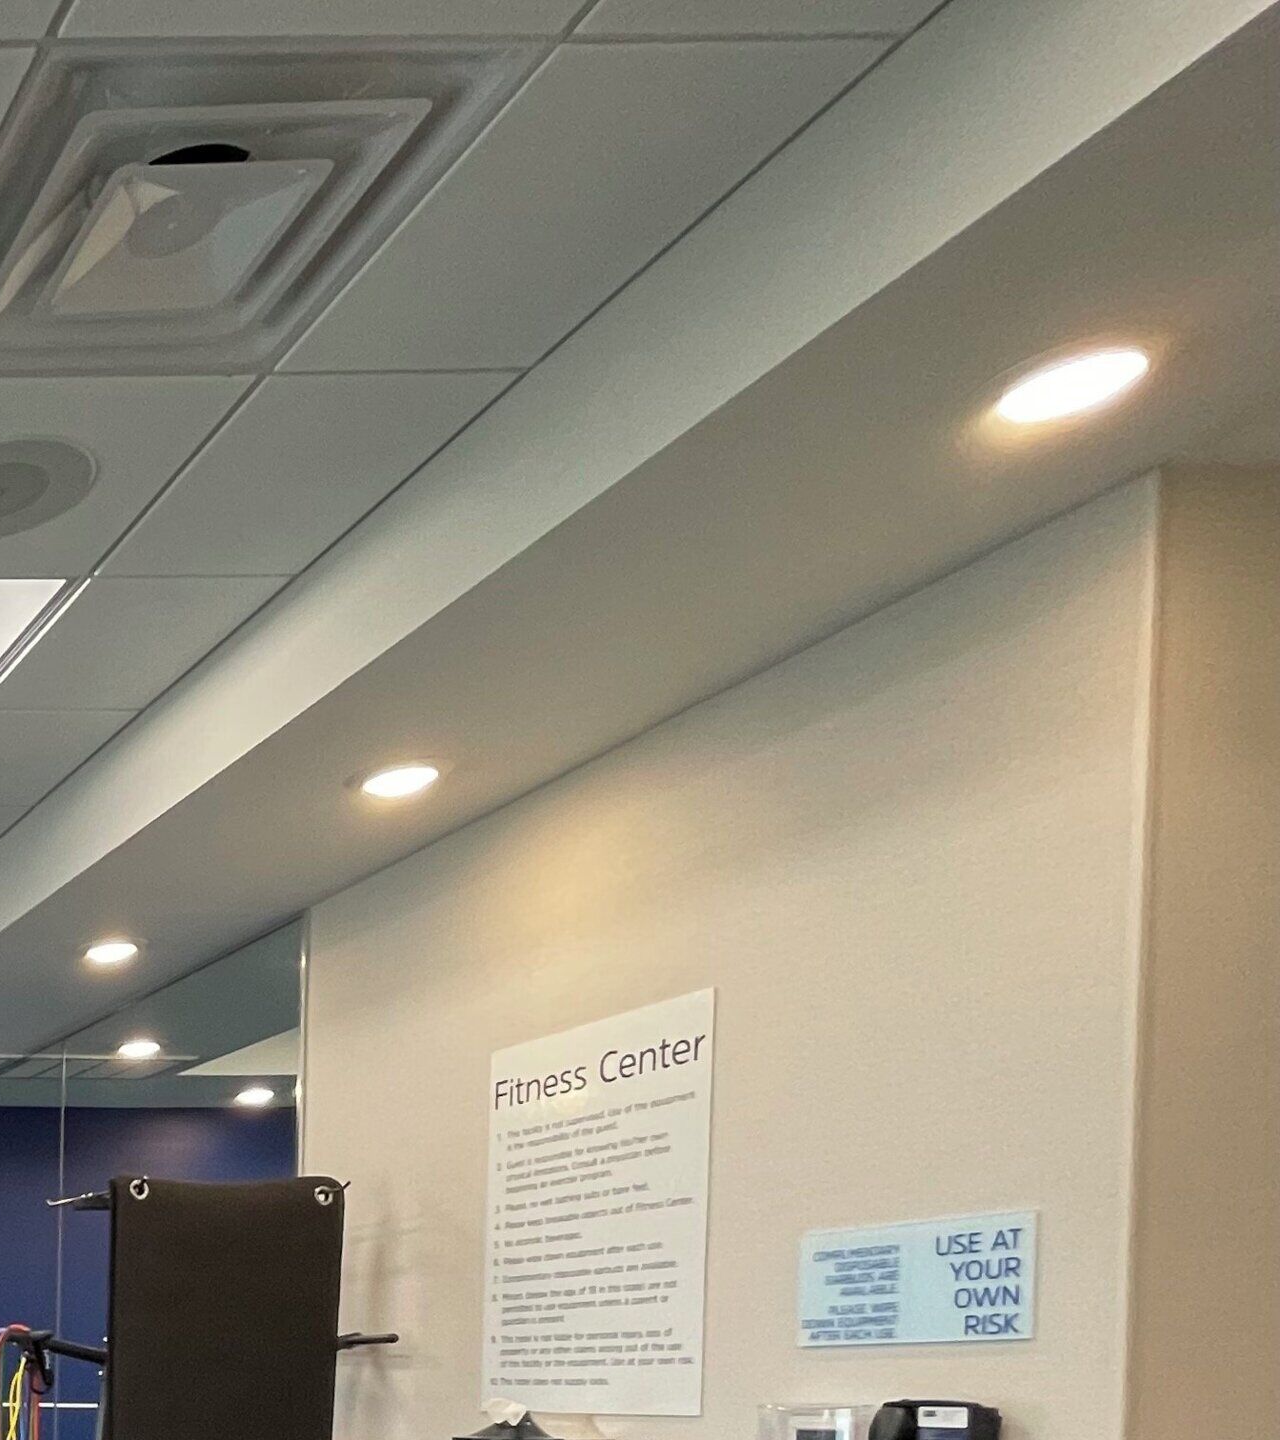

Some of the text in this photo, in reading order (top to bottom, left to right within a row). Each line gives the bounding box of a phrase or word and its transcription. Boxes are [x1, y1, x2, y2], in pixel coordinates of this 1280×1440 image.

[495, 1034, 706, 1110] Fitness Center
[935, 1227, 1023, 1257] USE AT
[949, 1256, 1022, 1282] YOUR
[953, 1284, 1021, 1309] OWN
[963, 1313, 1020, 1336] RISK
